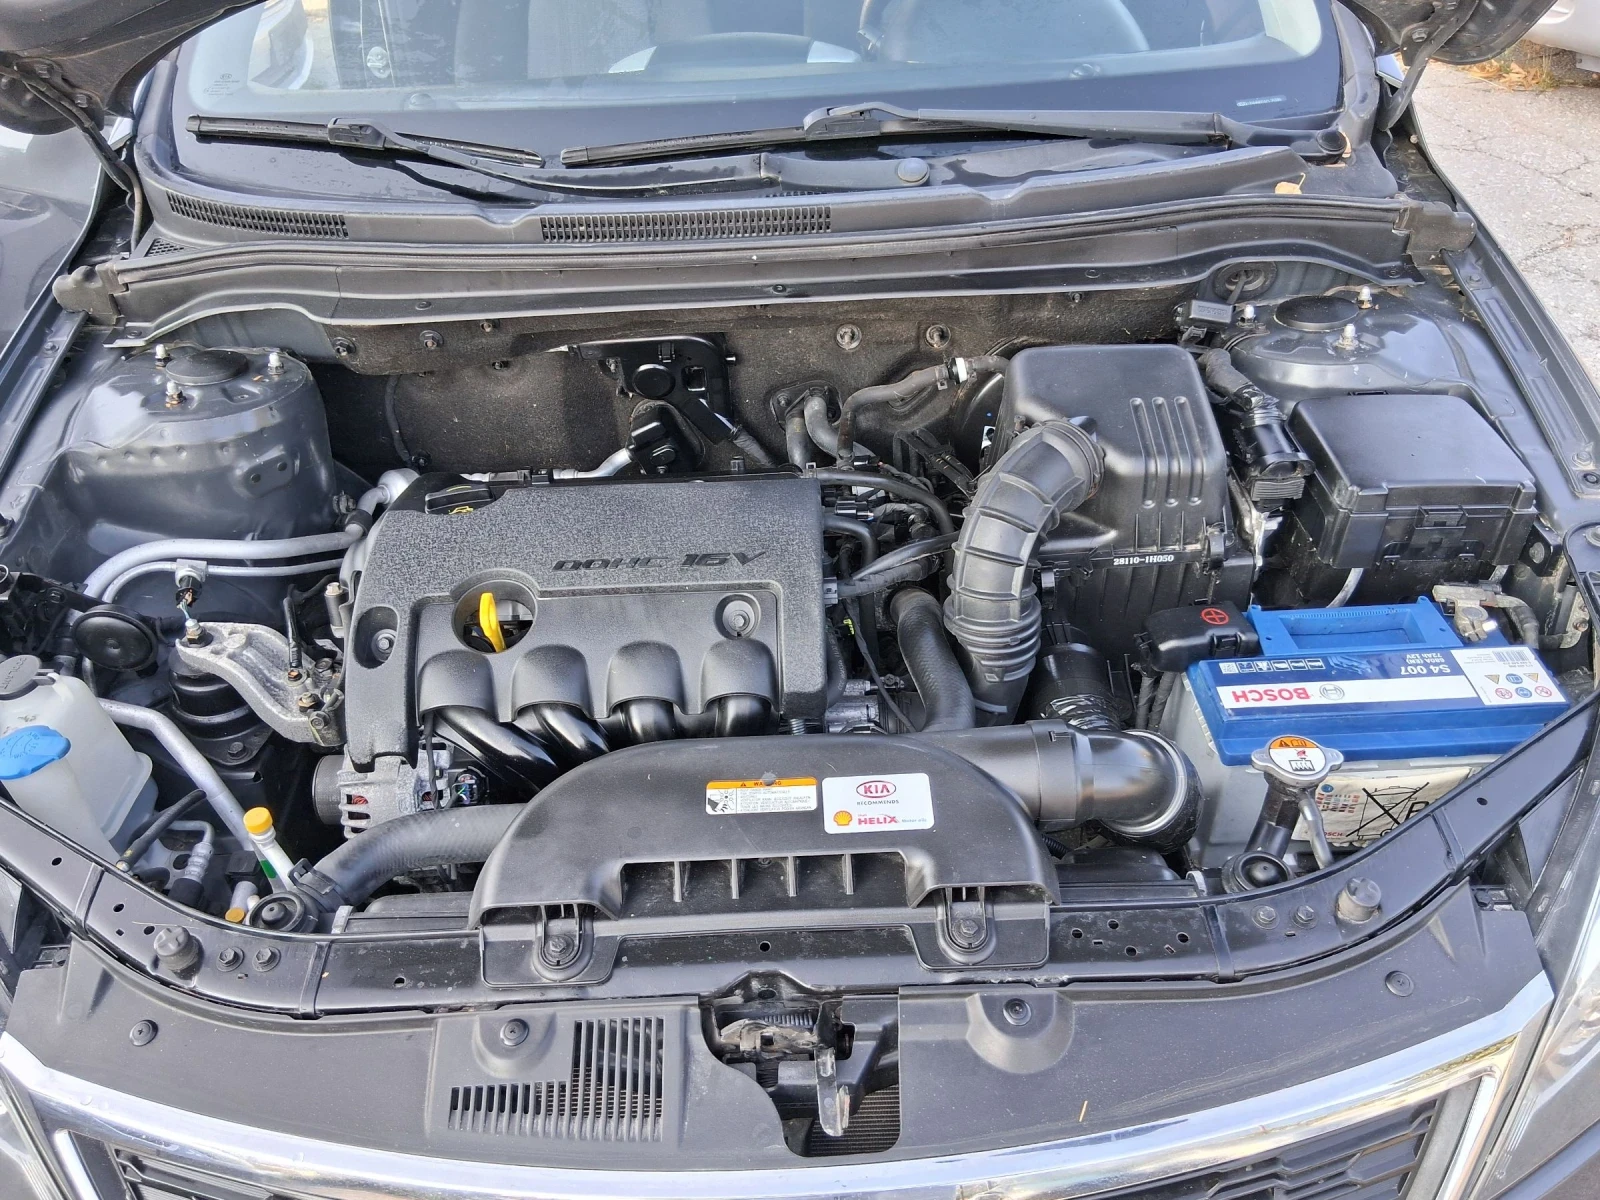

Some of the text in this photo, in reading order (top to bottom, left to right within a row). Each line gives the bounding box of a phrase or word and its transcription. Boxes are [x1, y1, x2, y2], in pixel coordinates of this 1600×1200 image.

[552, 551, 766, 571] DOHC 16V
[1113, 555, 1174, 566] 28110-1H050
[1406, 652, 1420, 660] 12V
[1400, 664, 1451, 676] S4 007
[1231, 687, 1310, 703] BOSCH
[863, 784, 890, 795] KIA
[858, 816, 898, 825] HELIX
